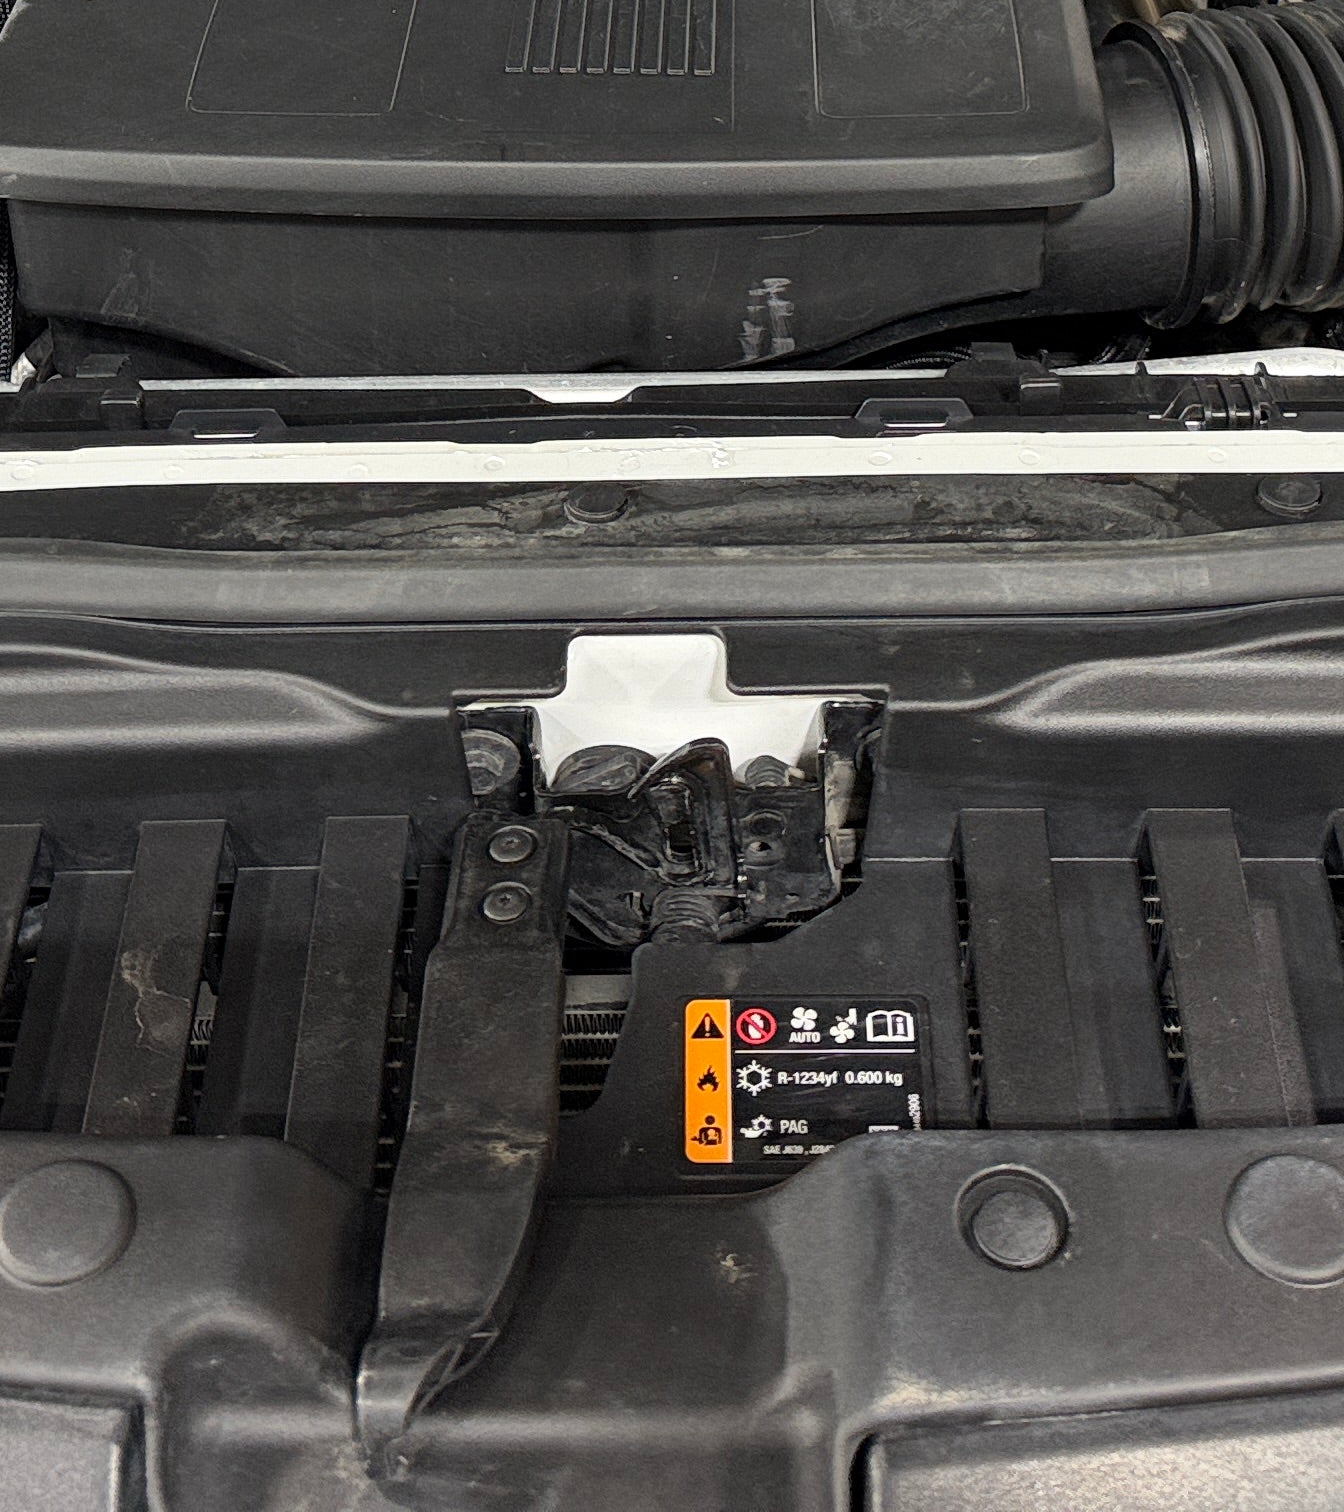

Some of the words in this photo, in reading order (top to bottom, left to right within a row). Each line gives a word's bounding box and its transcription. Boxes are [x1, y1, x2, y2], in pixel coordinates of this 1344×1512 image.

[789, 1032, 821, 1044] AUTO
[777, 1072, 838, 1086] R-1234yf
[844, 1072, 883, 1084] 0.600
[885, 1072, 904, 1087] kg
[780, 1120, 809, 1134] PAG
[763, 1145, 781, 1154] SAE
